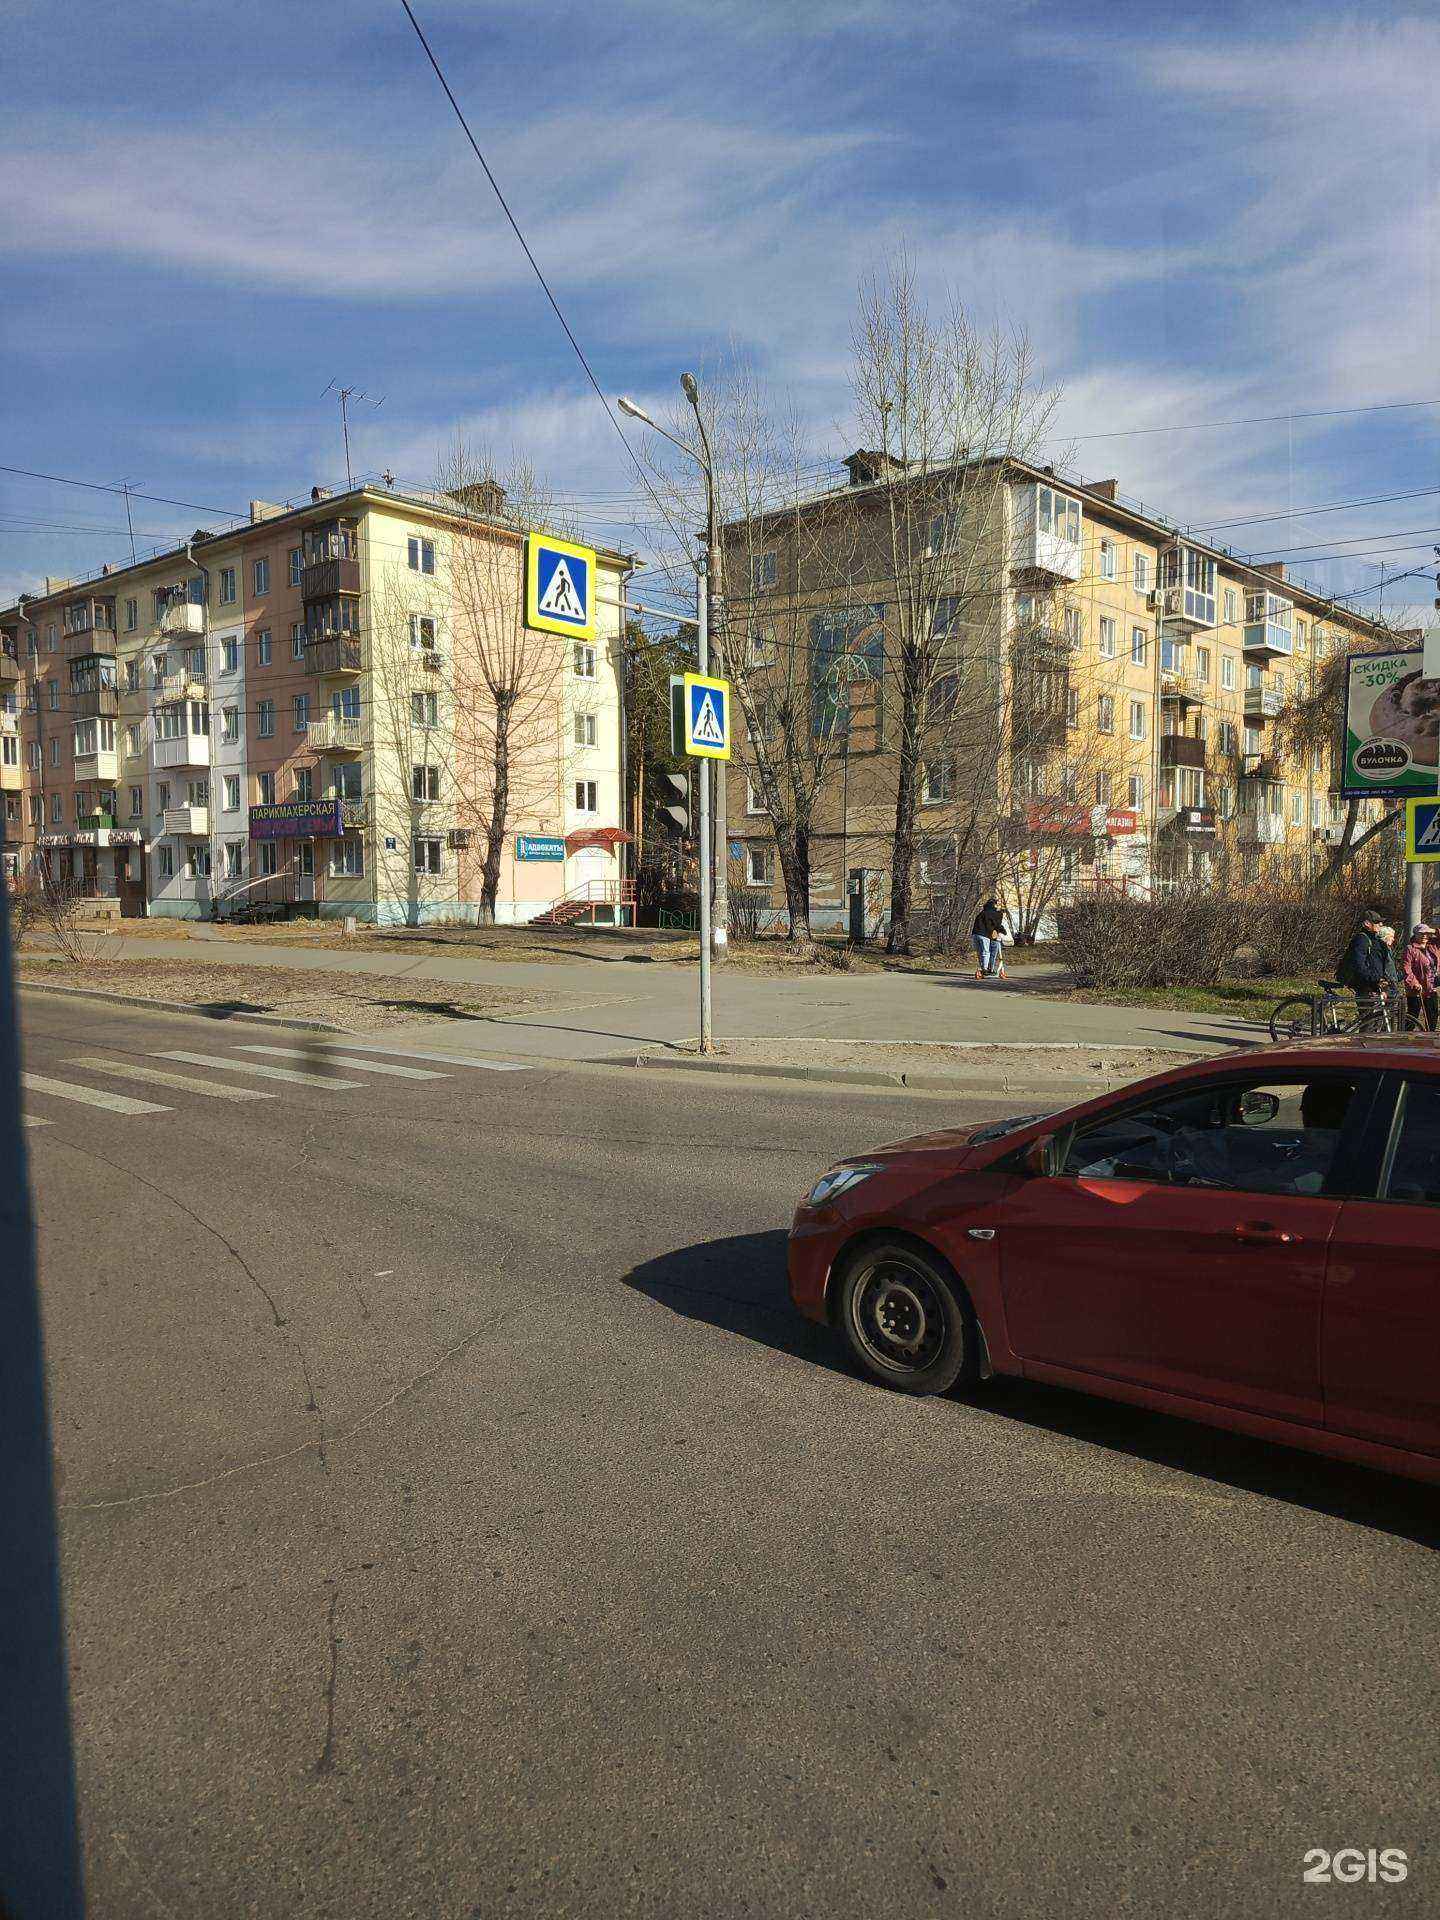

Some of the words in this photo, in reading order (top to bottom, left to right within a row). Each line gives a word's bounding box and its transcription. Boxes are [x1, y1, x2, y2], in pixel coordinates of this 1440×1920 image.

[1354, 659, 1408, 673] СКИДКА
[1360, 672, 1401, 687] -30%
[1361, 756, 1403, 765] БУЛОЧКА
[252, 803, 335, 819] ПАРИКМАХЕРСКАЯ
